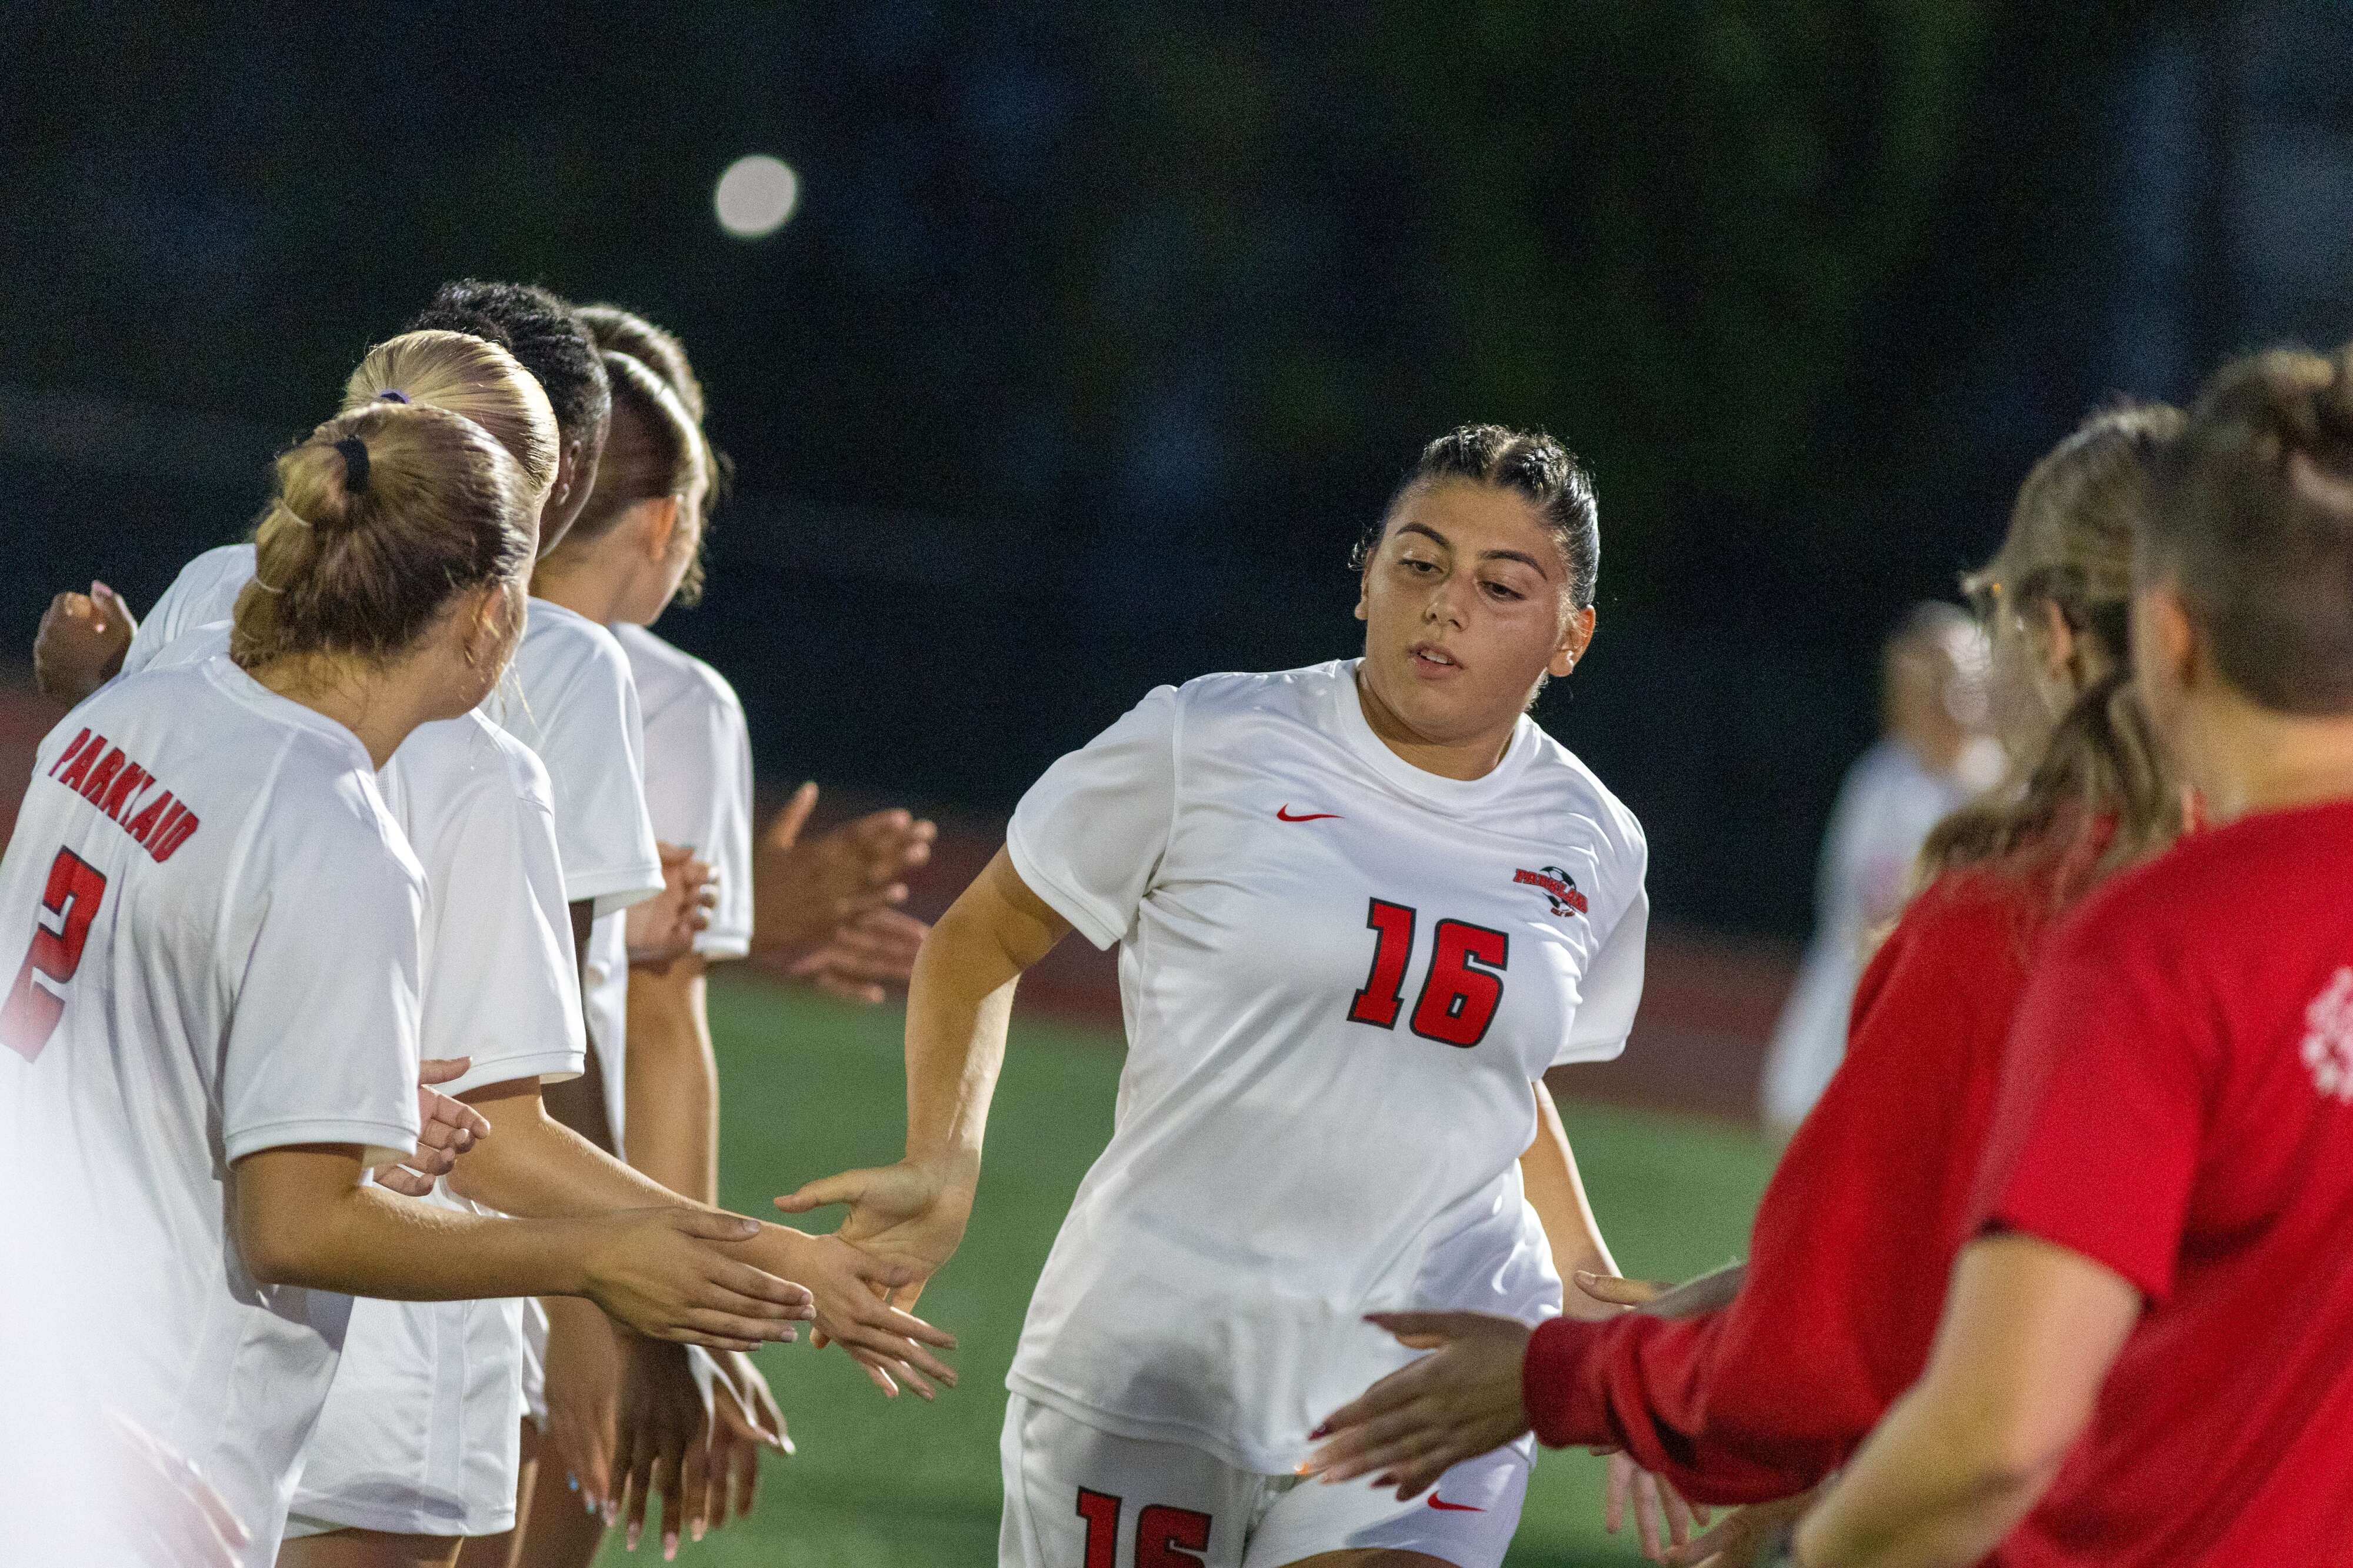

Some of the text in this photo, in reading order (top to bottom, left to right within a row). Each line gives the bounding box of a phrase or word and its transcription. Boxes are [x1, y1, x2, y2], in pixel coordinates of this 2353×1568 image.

[0, 844, 107, 1064] 2
[1347, 897, 1509, 1048] 16
[1076, 1485, 1212, 1568] 16
